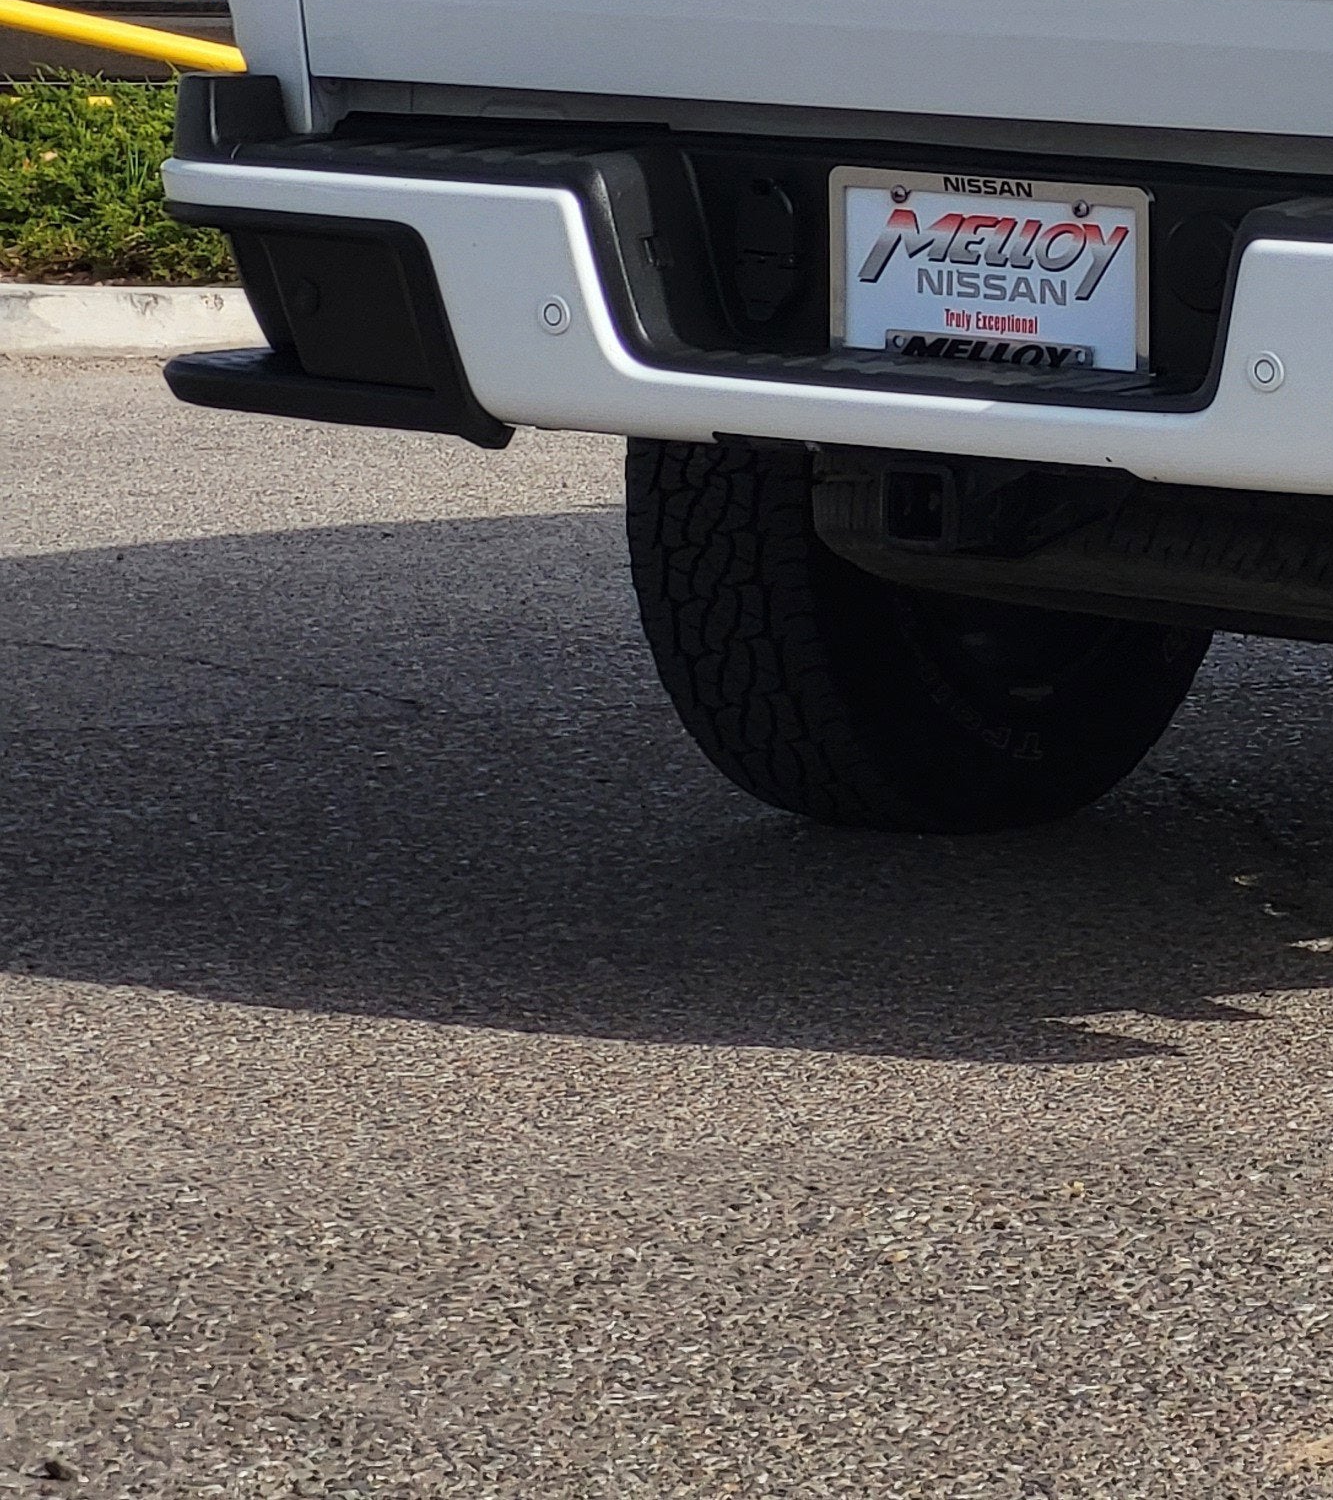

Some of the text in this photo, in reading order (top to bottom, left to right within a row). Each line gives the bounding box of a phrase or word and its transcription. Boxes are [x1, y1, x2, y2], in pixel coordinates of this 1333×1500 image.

[943, 176, 1033, 198] NISSAN
[858, 208, 1130, 300] MELLOY
[917, 268, 1067, 306] NISSAN
[944, 308, 1038, 335] Truly Exceptional
[902, 336, 1073, 367] MELLOY
